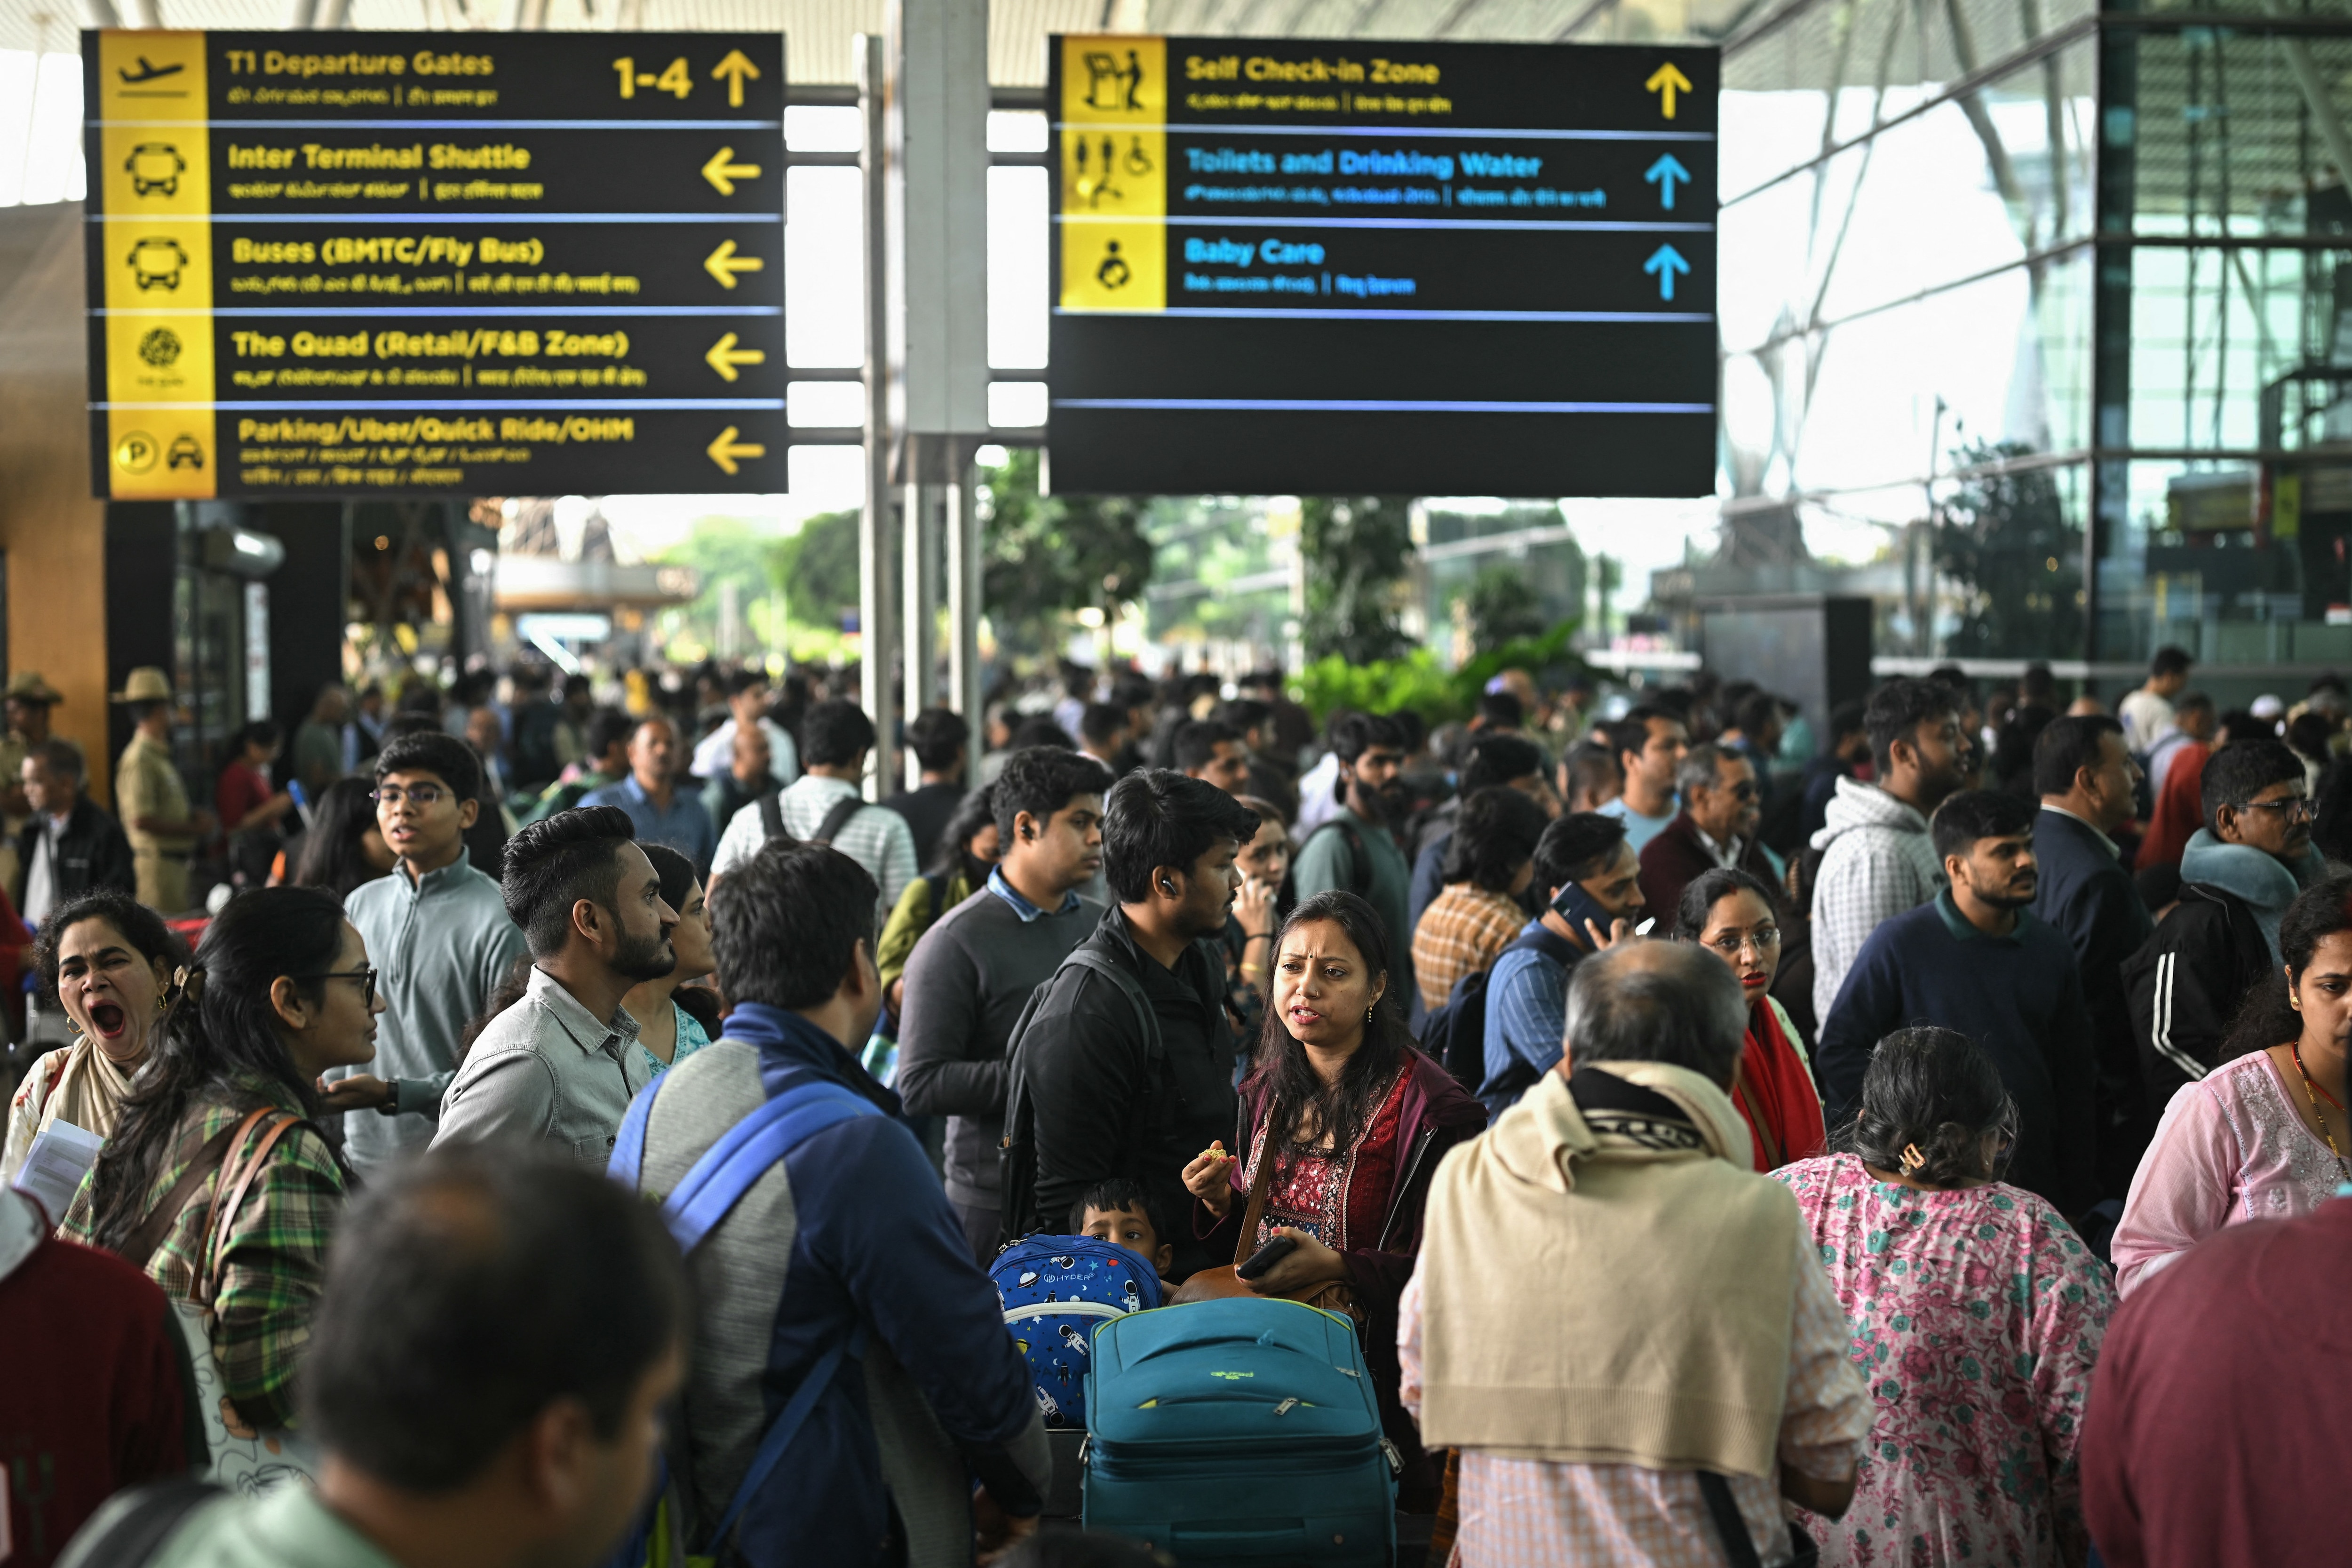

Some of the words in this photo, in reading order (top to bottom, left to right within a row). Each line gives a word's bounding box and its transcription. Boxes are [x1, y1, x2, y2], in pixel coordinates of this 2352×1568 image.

[226, 51, 256, 73] T1
[265, 51, 405, 77] Departure
[413, 51, 493, 75] Gates
[613, 57, 693, 99] 1-4
[1186, 56, 1239, 80] Self
[1245, 57, 1364, 81] Check-in
[1371, 59, 1439, 83] Zone
[229, 144, 296, 169] Inter
[302, 144, 423, 169] Terminal
[429, 144, 531, 169] Shuttle
[1186, 148, 1276, 173] Toilets
[1280, 151, 1333, 174] and
[1339, 149, 1454, 180] Drinking
[1460, 152, 1542, 177] Water
[232, 238, 316, 263] Buses
[321, 236, 474, 267] (BMTC/Fly
[479, 237, 544, 265] Bus)
[1184, 238, 1255, 268] Baby
[1260, 238, 1326, 264] Care
[231, 331, 286, 357] The
[291, 331, 369, 357] Quad
[374, 329, 540, 359] (Retail/F&B
[544, 330, 629, 358] Zone)
[238, 417, 494, 444] Parking/Uber/Quick
[501, 416, 634, 443] Ride/OHM
